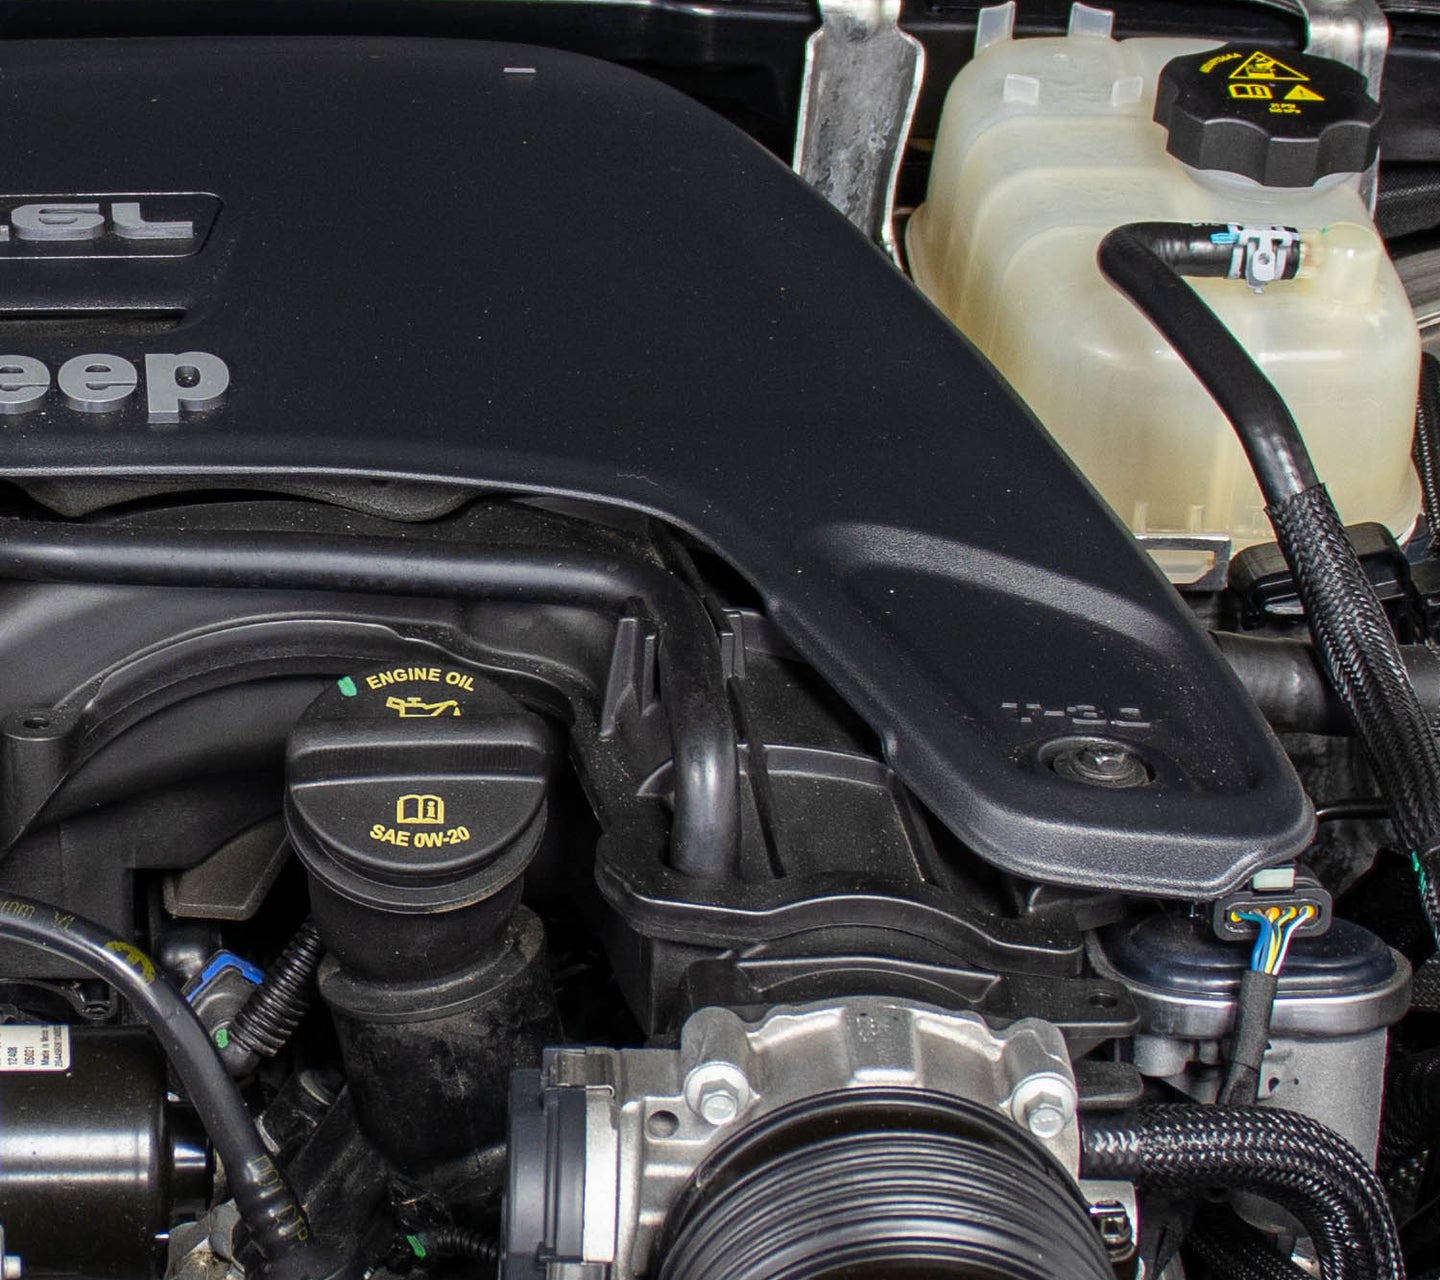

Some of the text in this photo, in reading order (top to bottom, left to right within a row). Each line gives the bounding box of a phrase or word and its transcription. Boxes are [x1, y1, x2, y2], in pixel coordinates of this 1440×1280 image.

[366, 667, 476, 692] ENGINE OIL
[370, 823, 471, 848] SAE 0W-20
